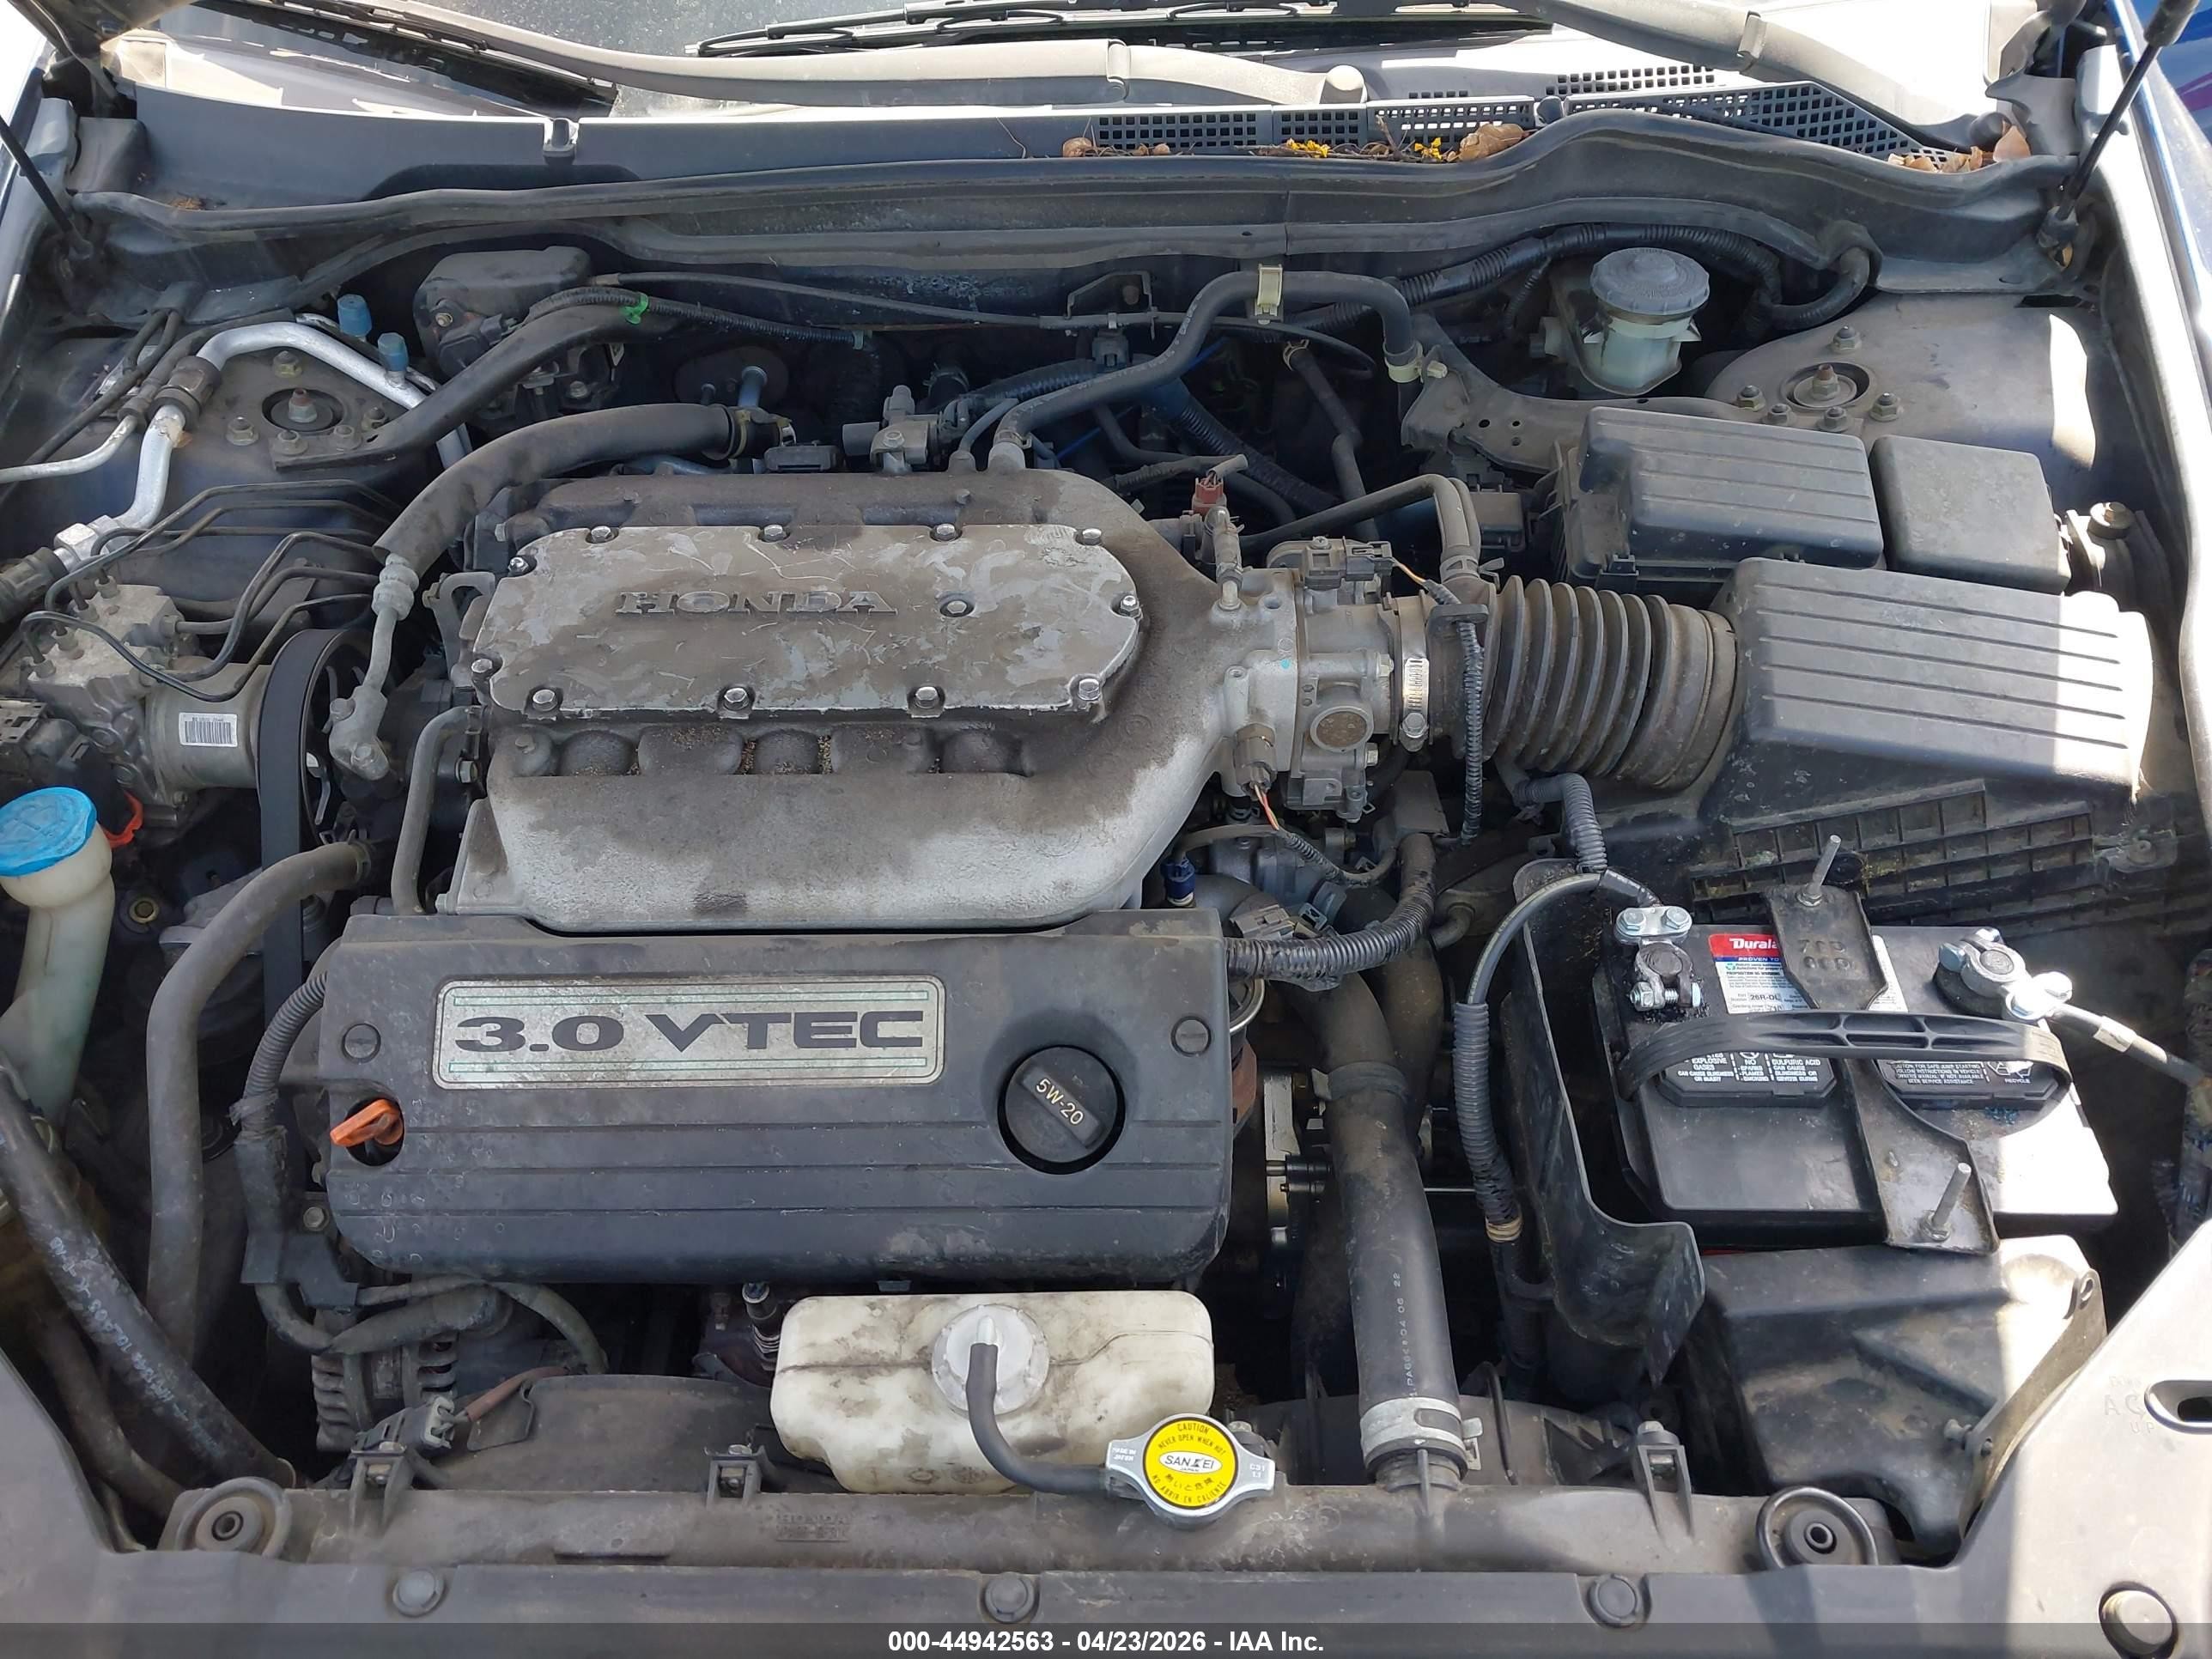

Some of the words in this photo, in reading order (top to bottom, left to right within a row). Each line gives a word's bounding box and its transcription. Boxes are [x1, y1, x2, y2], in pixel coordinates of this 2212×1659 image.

[615, 591, 898, 616] HONDA
[455, 1015, 625, 1052] 3.0
[645, 1011, 924, 1053] VTEC
[1036, 1078, 1084, 1125] 5W-20
[1177, 1422, 1210, 1434] CAUTION
[1158, 1436, 1176, 1449] NEVER
[1178, 1433, 1194, 1442] OPEN
[1197, 1436, 1213, 1448] WHEN
[1214, 1444, 1227, 1455] HOT
[1164, 1455, 1214, 1469] SANKEI
[1152, 1474, 1161, 1485] NO
[1161, 1486, 1180, 1500] ABRIR
[1196, 1480, 1227, 1504] CALIENTE
